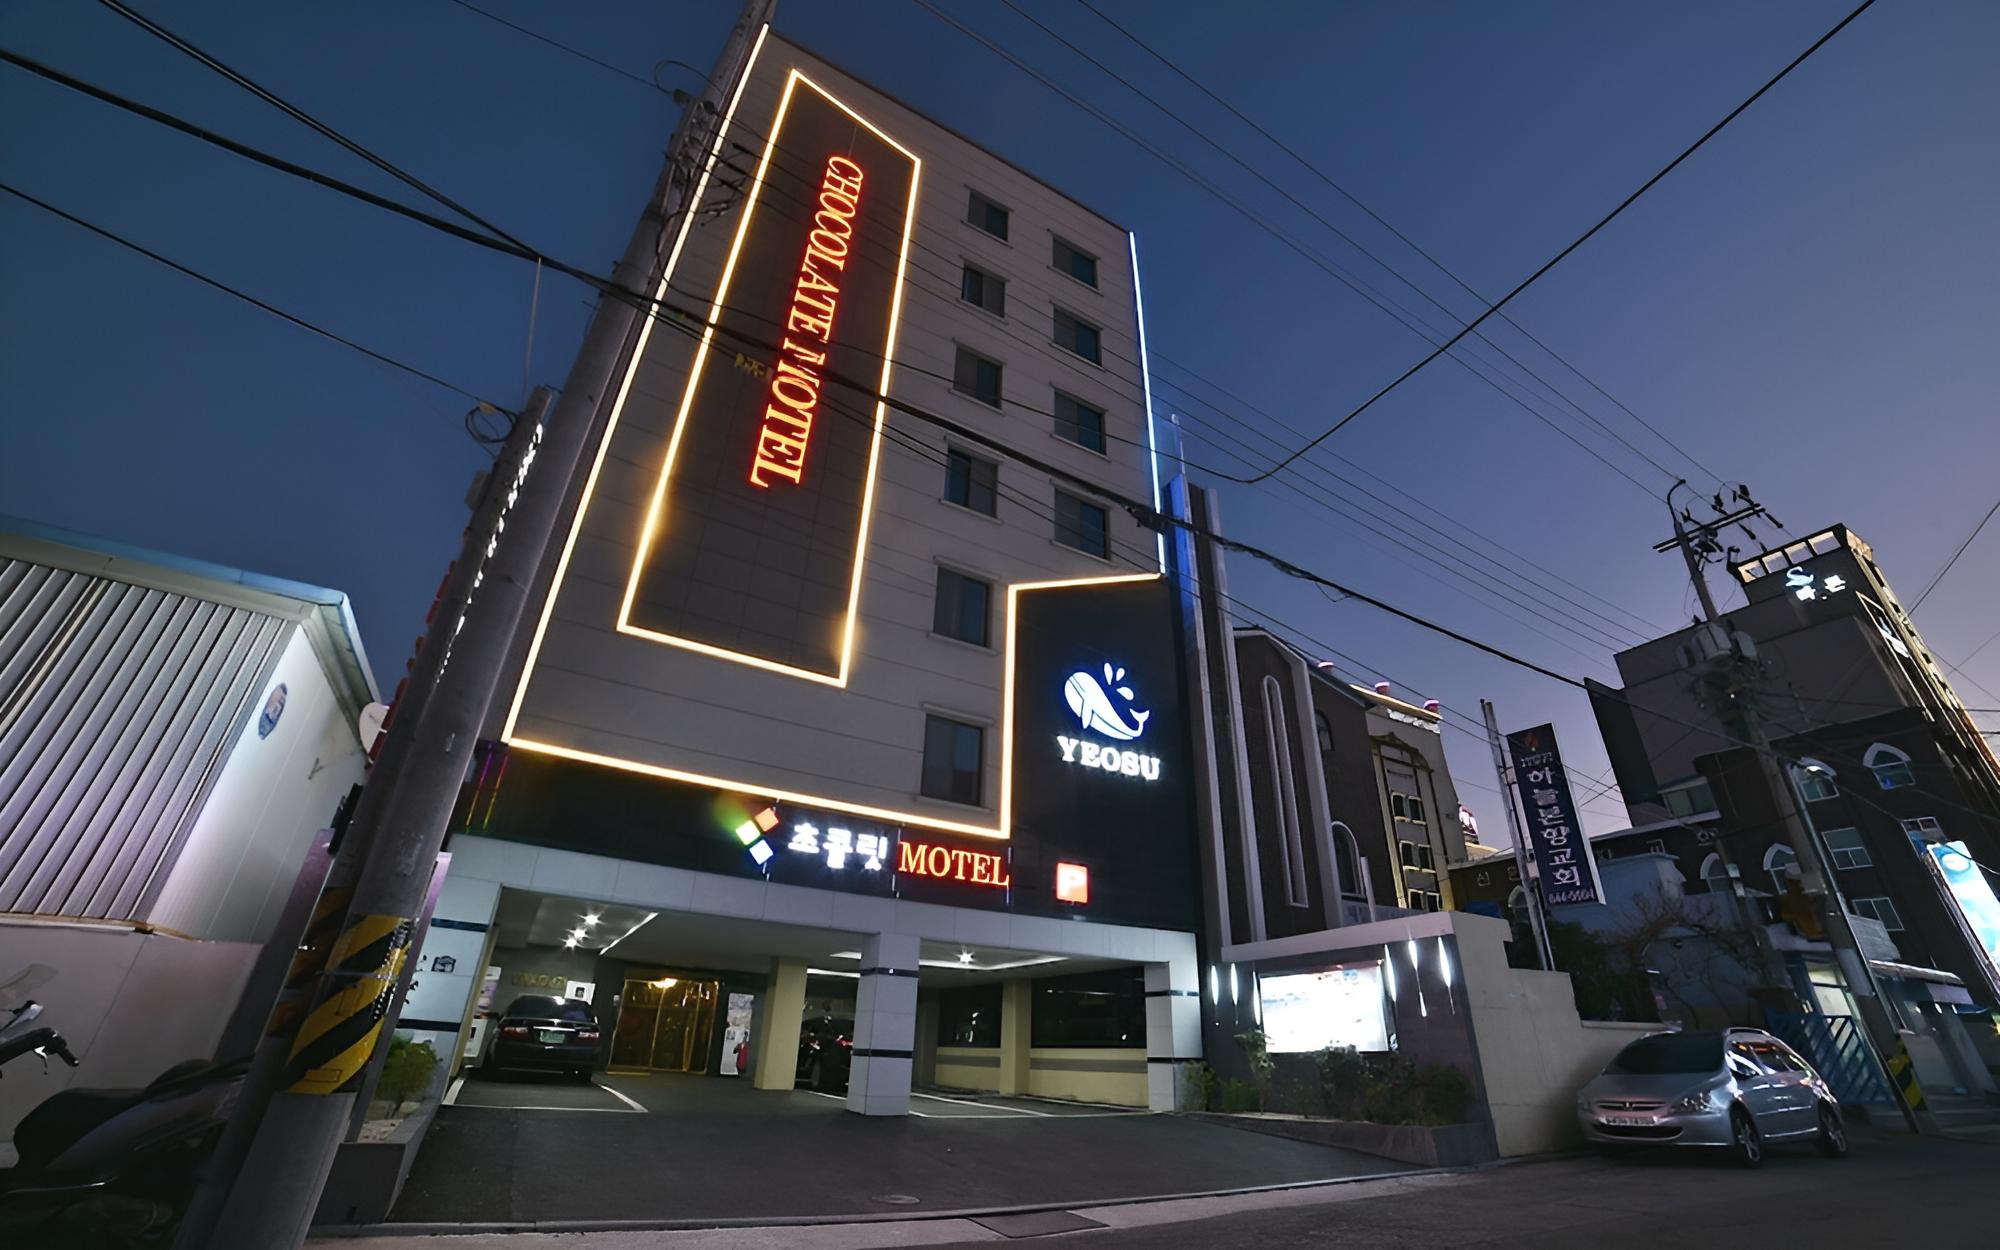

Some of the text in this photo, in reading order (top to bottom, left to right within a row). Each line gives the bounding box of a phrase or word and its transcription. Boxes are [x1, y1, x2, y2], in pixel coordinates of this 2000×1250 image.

[787, 156, 863, 340] CHOCOLATE
[749, 338, 827, 489] MOTEL
[1056, 735, 1161, 781] YEOSU
[787, 822, 1010, 887] 초콜릿 MOTEL
[1059, 867, 1084, 898] P
